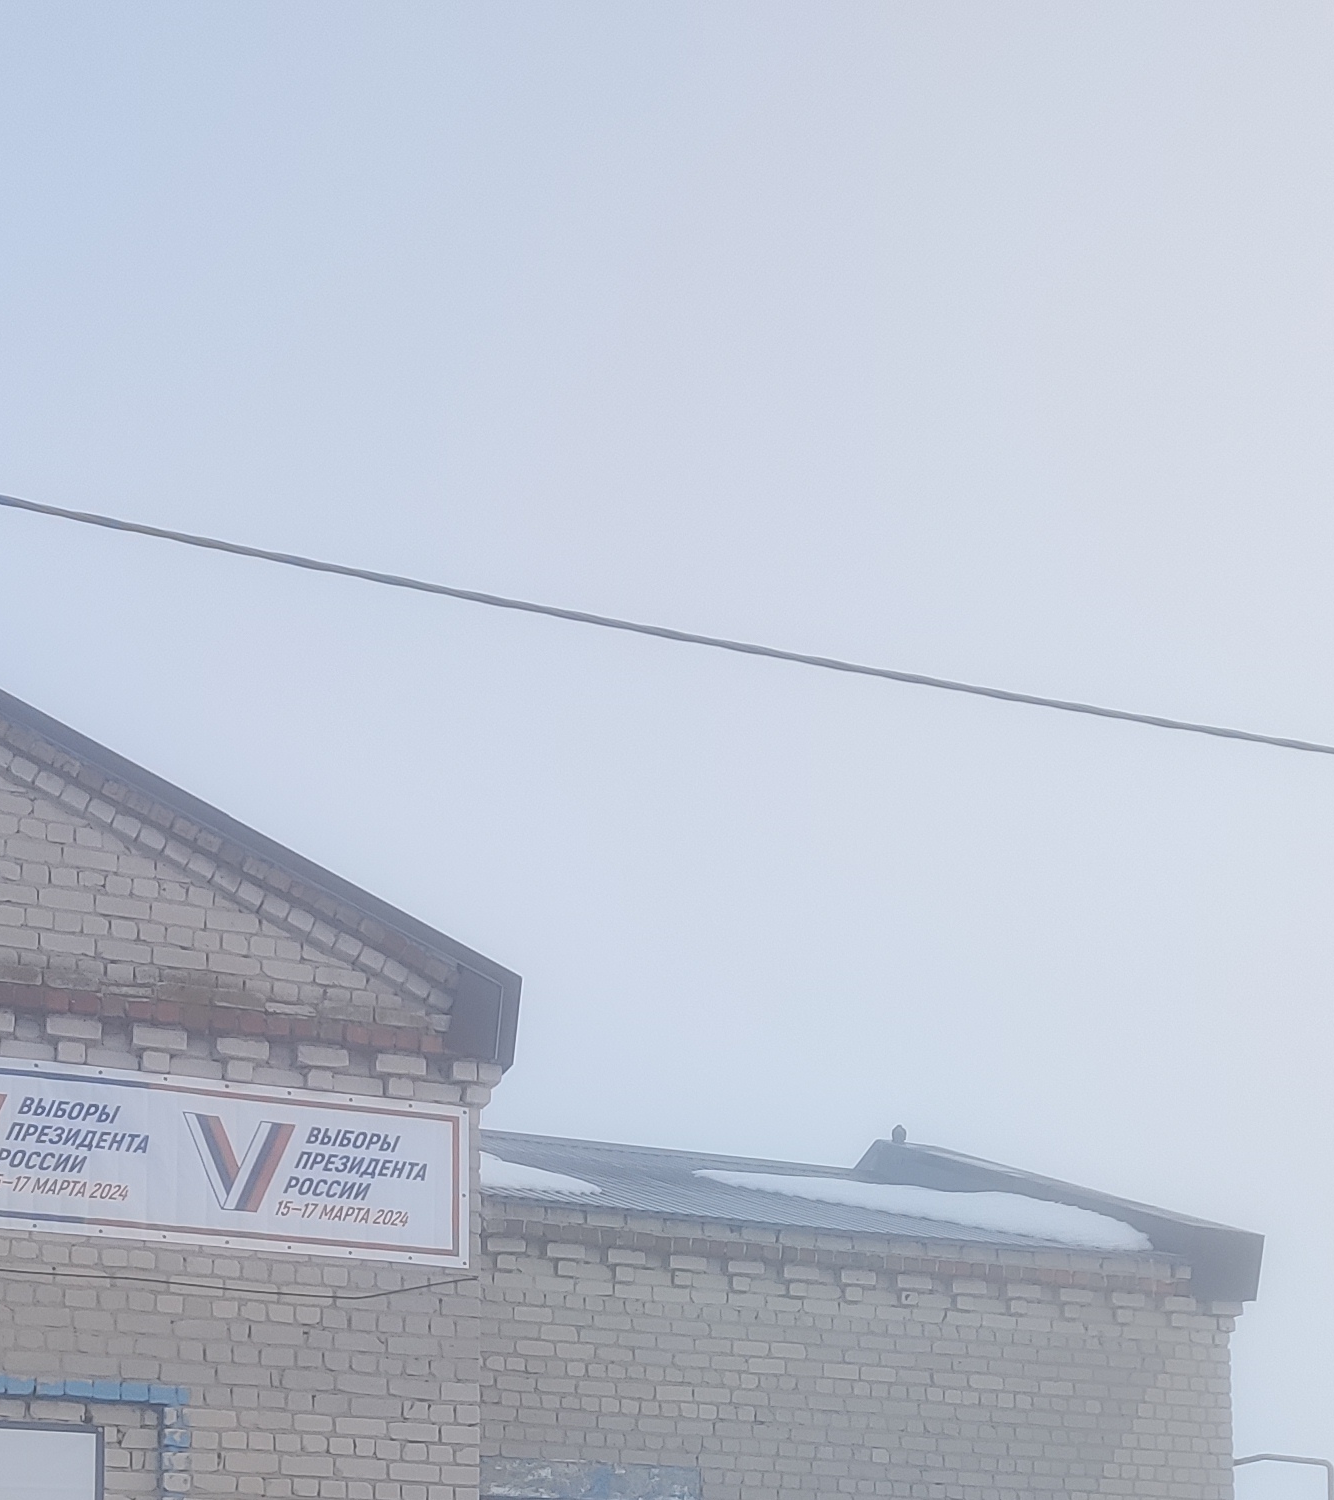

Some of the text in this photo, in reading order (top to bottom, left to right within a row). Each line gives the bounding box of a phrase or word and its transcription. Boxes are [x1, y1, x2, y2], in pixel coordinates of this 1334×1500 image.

[17, 1096, 121, 1124] ВЫБОРЫ
[5, 1121, 150, 1154] ПРЕЗИДЕНТА
[305, 1126, 401, 1153] ВЫБОРЫ
[294, 1151, 428, 1181] ПРЕЗИДЕНТА
[31, 1177, 88, 1198] МАРТА
[89, 1182, 129, 1201] 2024
[283, 1175, 372, 1201] РОССИИ
[318, 1204, 371, 1224] МАРТА
[372, 1209, 409, 1227] 2024
